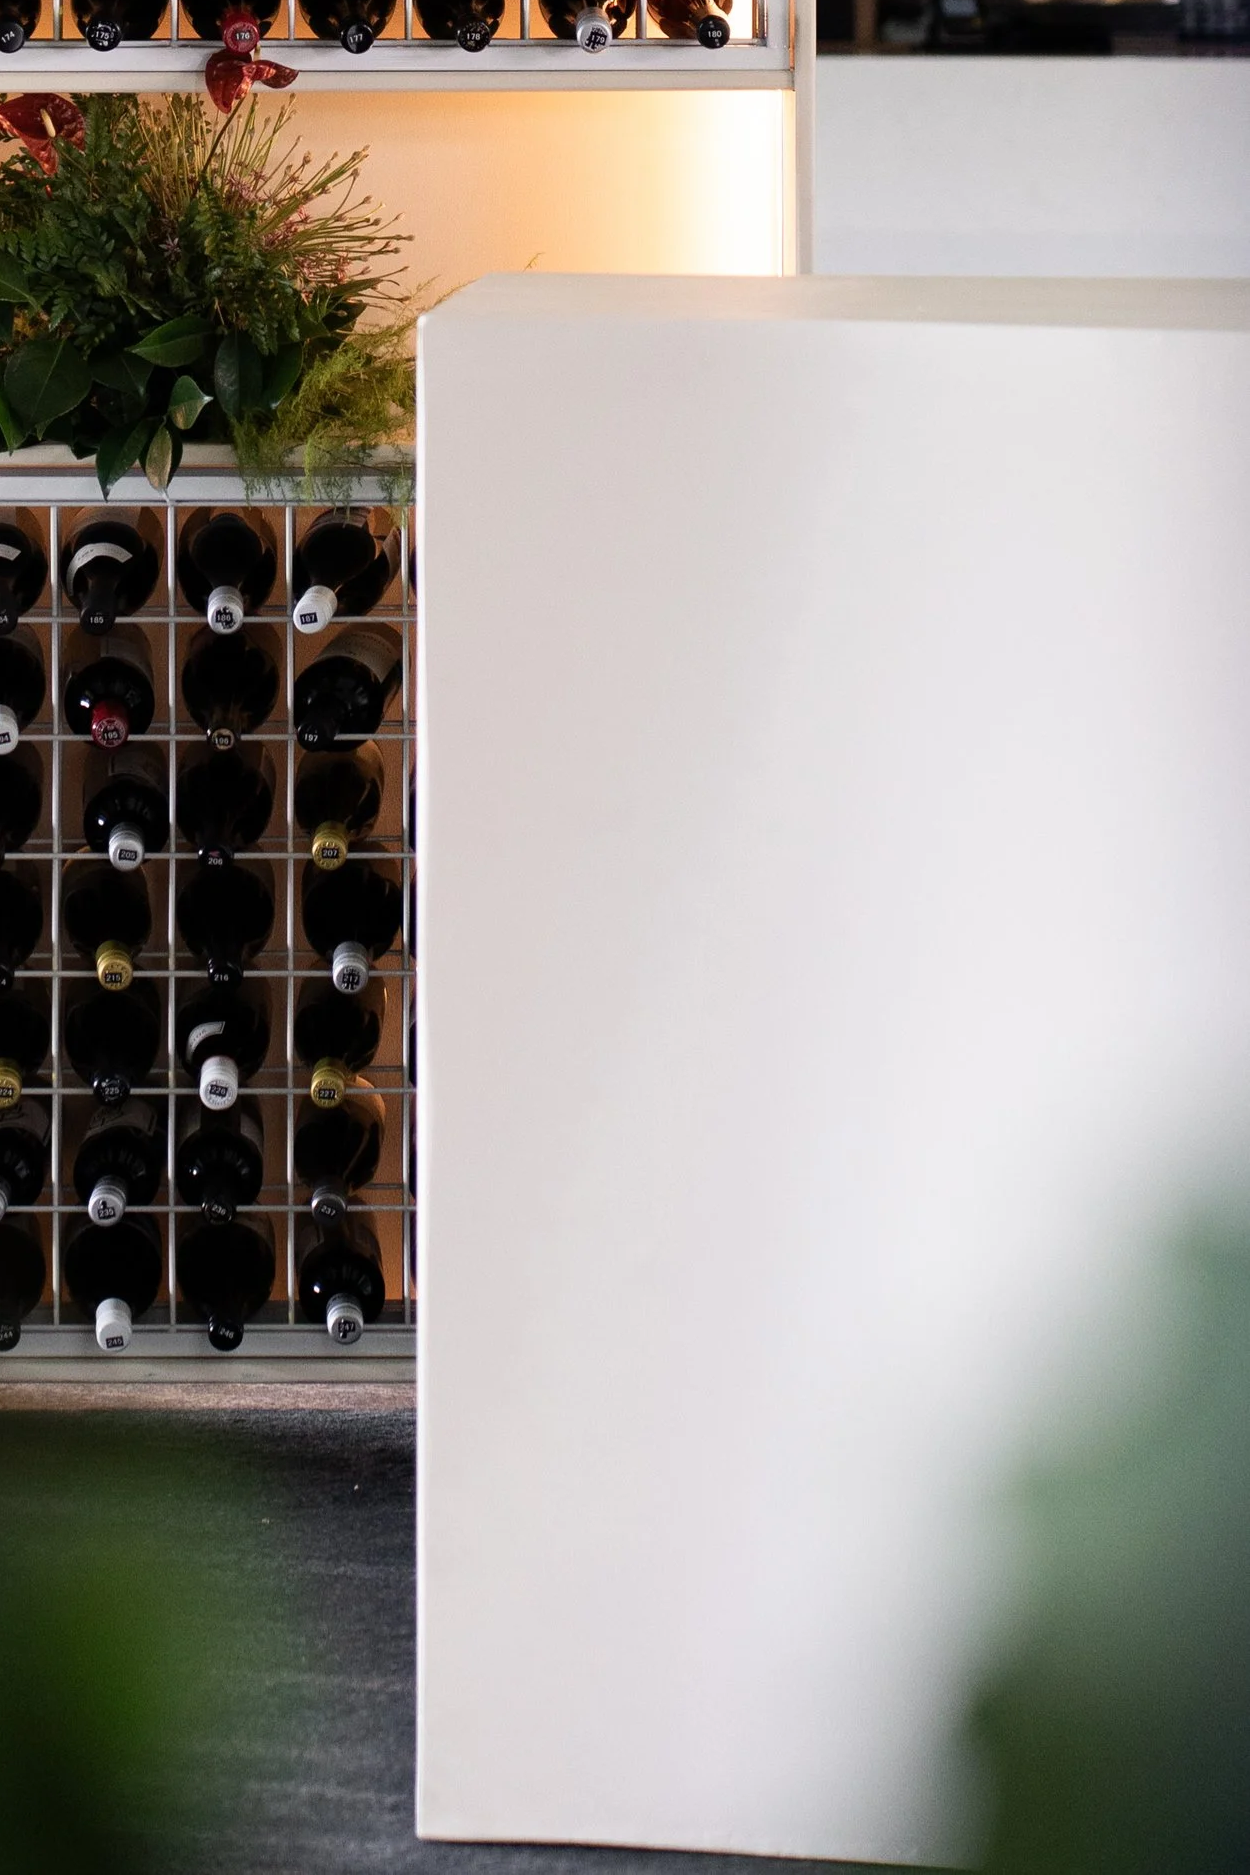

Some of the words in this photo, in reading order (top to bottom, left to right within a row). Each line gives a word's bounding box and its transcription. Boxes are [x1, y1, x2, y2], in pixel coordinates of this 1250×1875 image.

[1, 31, 15, 43] 174
[96, 31, 109, 40] 175
[236, 32, 250, 40] 176
[349, 33, 363, 43] 177
[708, 30, 722, 38] 180
[591, 35, 605, 44] 179
[90, 616, 104, 624] 185
[217, 614, 231, 622] 186
[301, 614, 315, 623] 187
[305, 733, 318, 742] 197
[121, 851, 135, 859] 205
[208, 857, 223, 865] 206
[106, 974, 121, 982] 215
